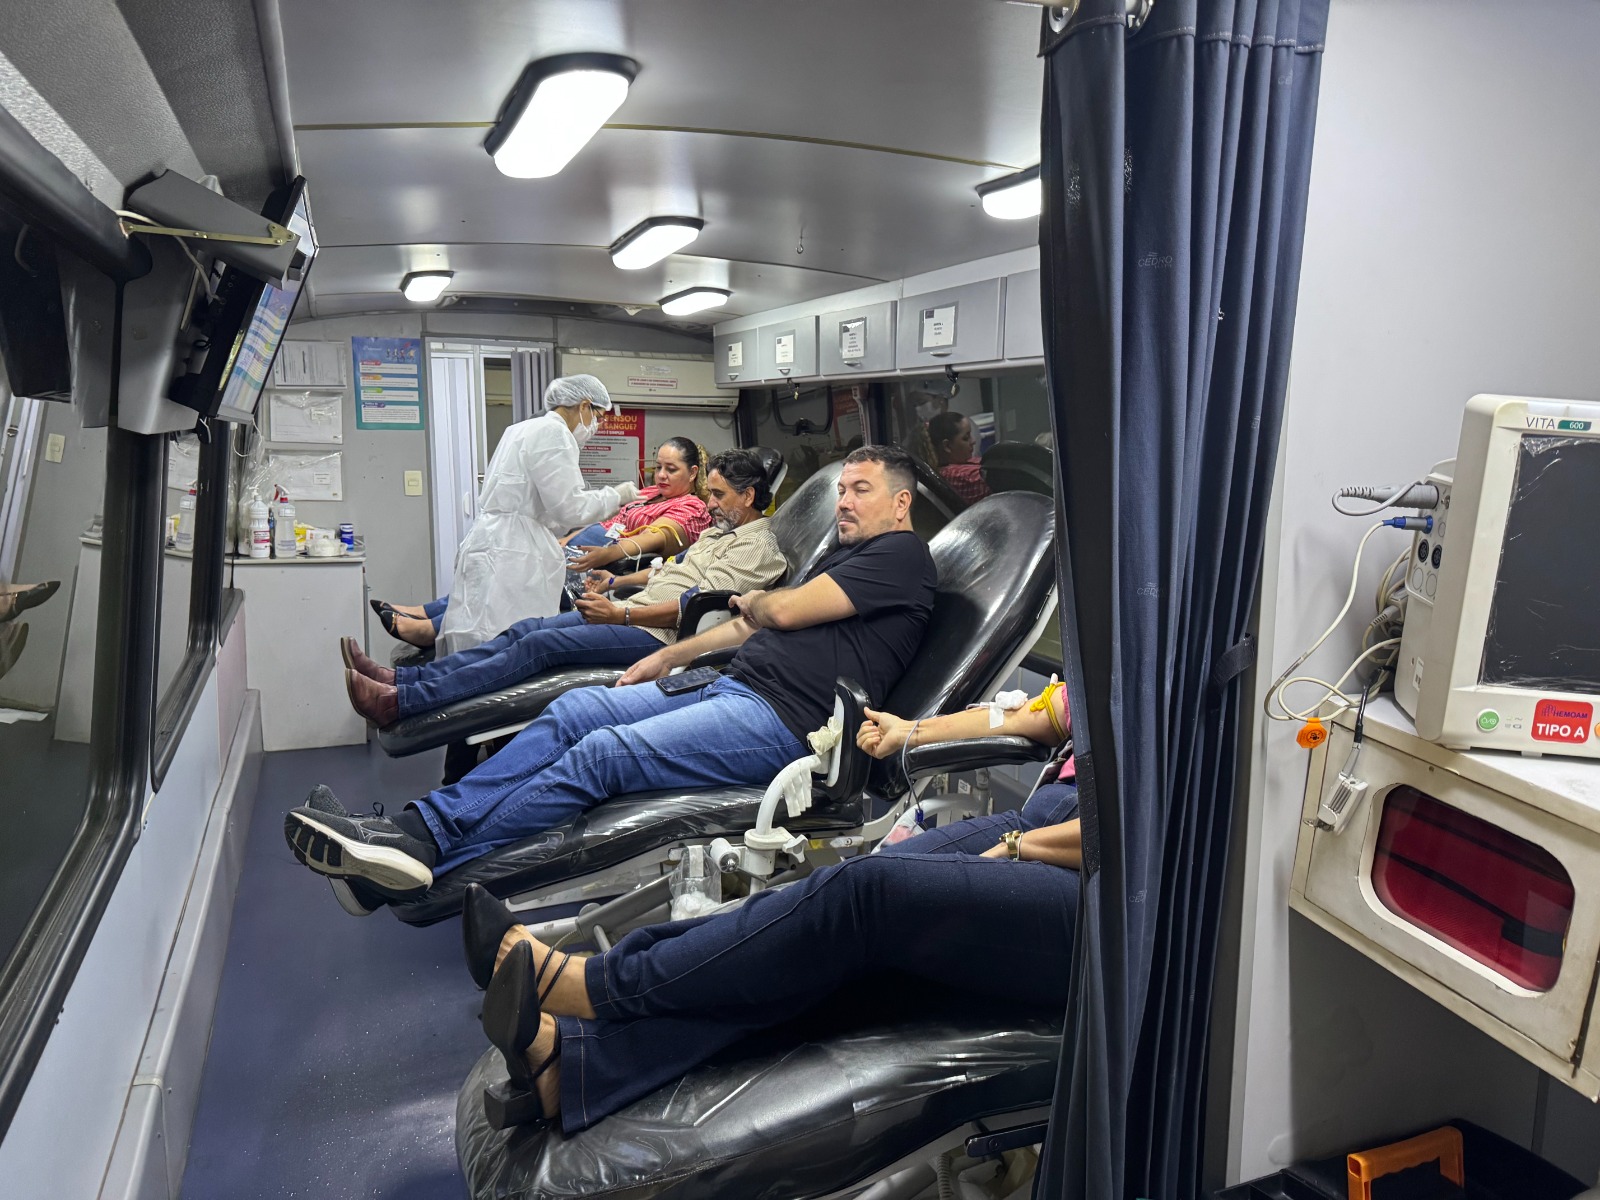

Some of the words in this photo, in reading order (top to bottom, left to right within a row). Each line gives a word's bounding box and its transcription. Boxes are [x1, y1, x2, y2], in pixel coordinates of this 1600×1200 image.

[1138, 255, 1173, 267] CEDRO
[604, 423, 637, 431] SANGUE?
[1526, 416, 1556, 430] VITA
[1569, 421, 1584, 430] 600
[1536, 723, 1571, 737] TIPO
[1573, 725, 1585, 739] A
